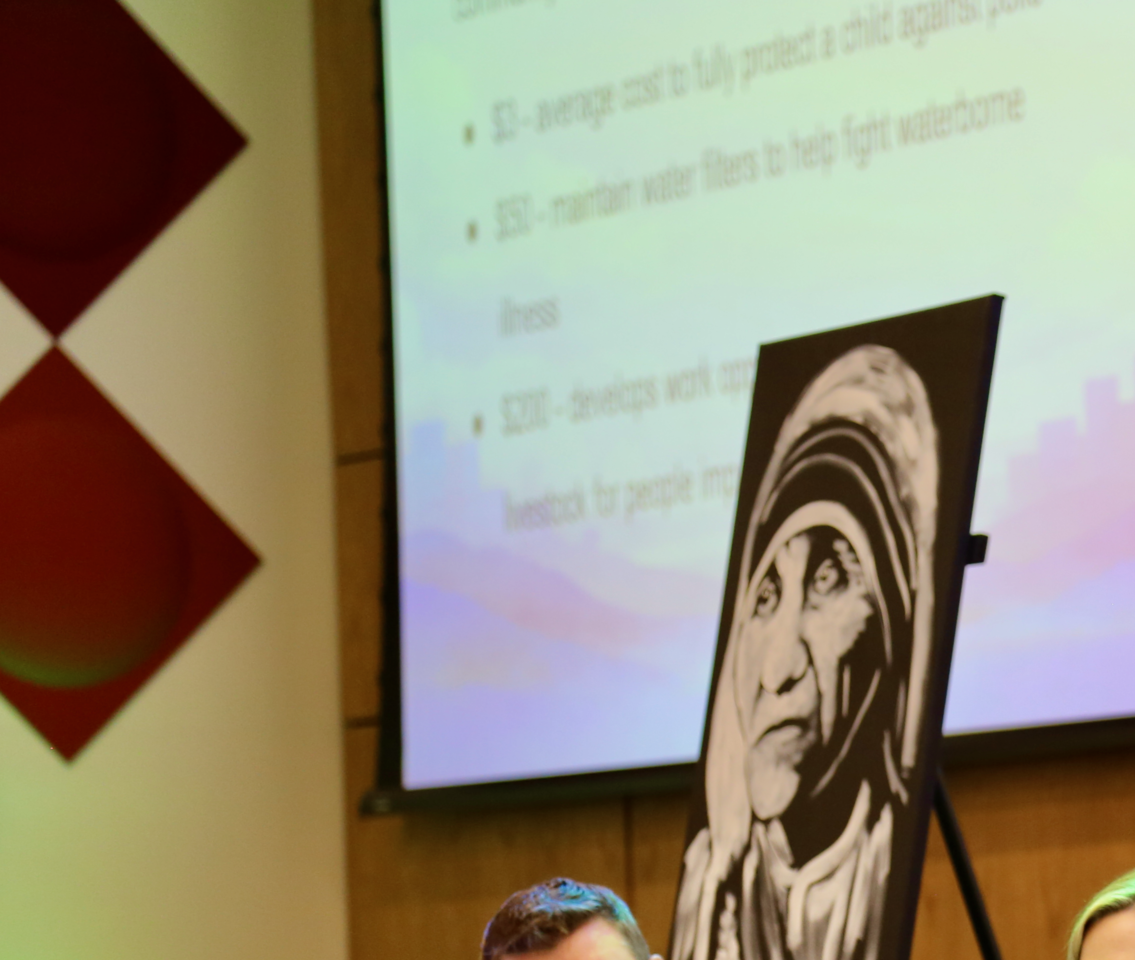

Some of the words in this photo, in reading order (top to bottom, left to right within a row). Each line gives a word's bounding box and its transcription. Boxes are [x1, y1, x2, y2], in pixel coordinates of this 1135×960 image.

[534, 81, 617, 132] average
[620, 60, 664, 111] cost
[666, 57, 691, 98] to
[692, 40, 735, 98] fully
[738, 21, 816, 93] protect
[819, 24, 837, 60] a
[839, 0, 893, 55] child
[549, 168, 635, 228] maintain
[640, 159, 696, 207] water
[699, 145, 759, 192] filters
[762, 135, 787, 178] to
[788, 120, 838, 177] help
[841, 107, 892, 171] fight
[897, 86, 1028, 148] waterborne
[498, 294, 561, 337] illness
[569, 371, 659, 423] develops
[664, 354, 711, 405] work
[501, 475, 585, 532] livestock
[593, 472, 620, 517] for
[622, 459, 694, 524] people
